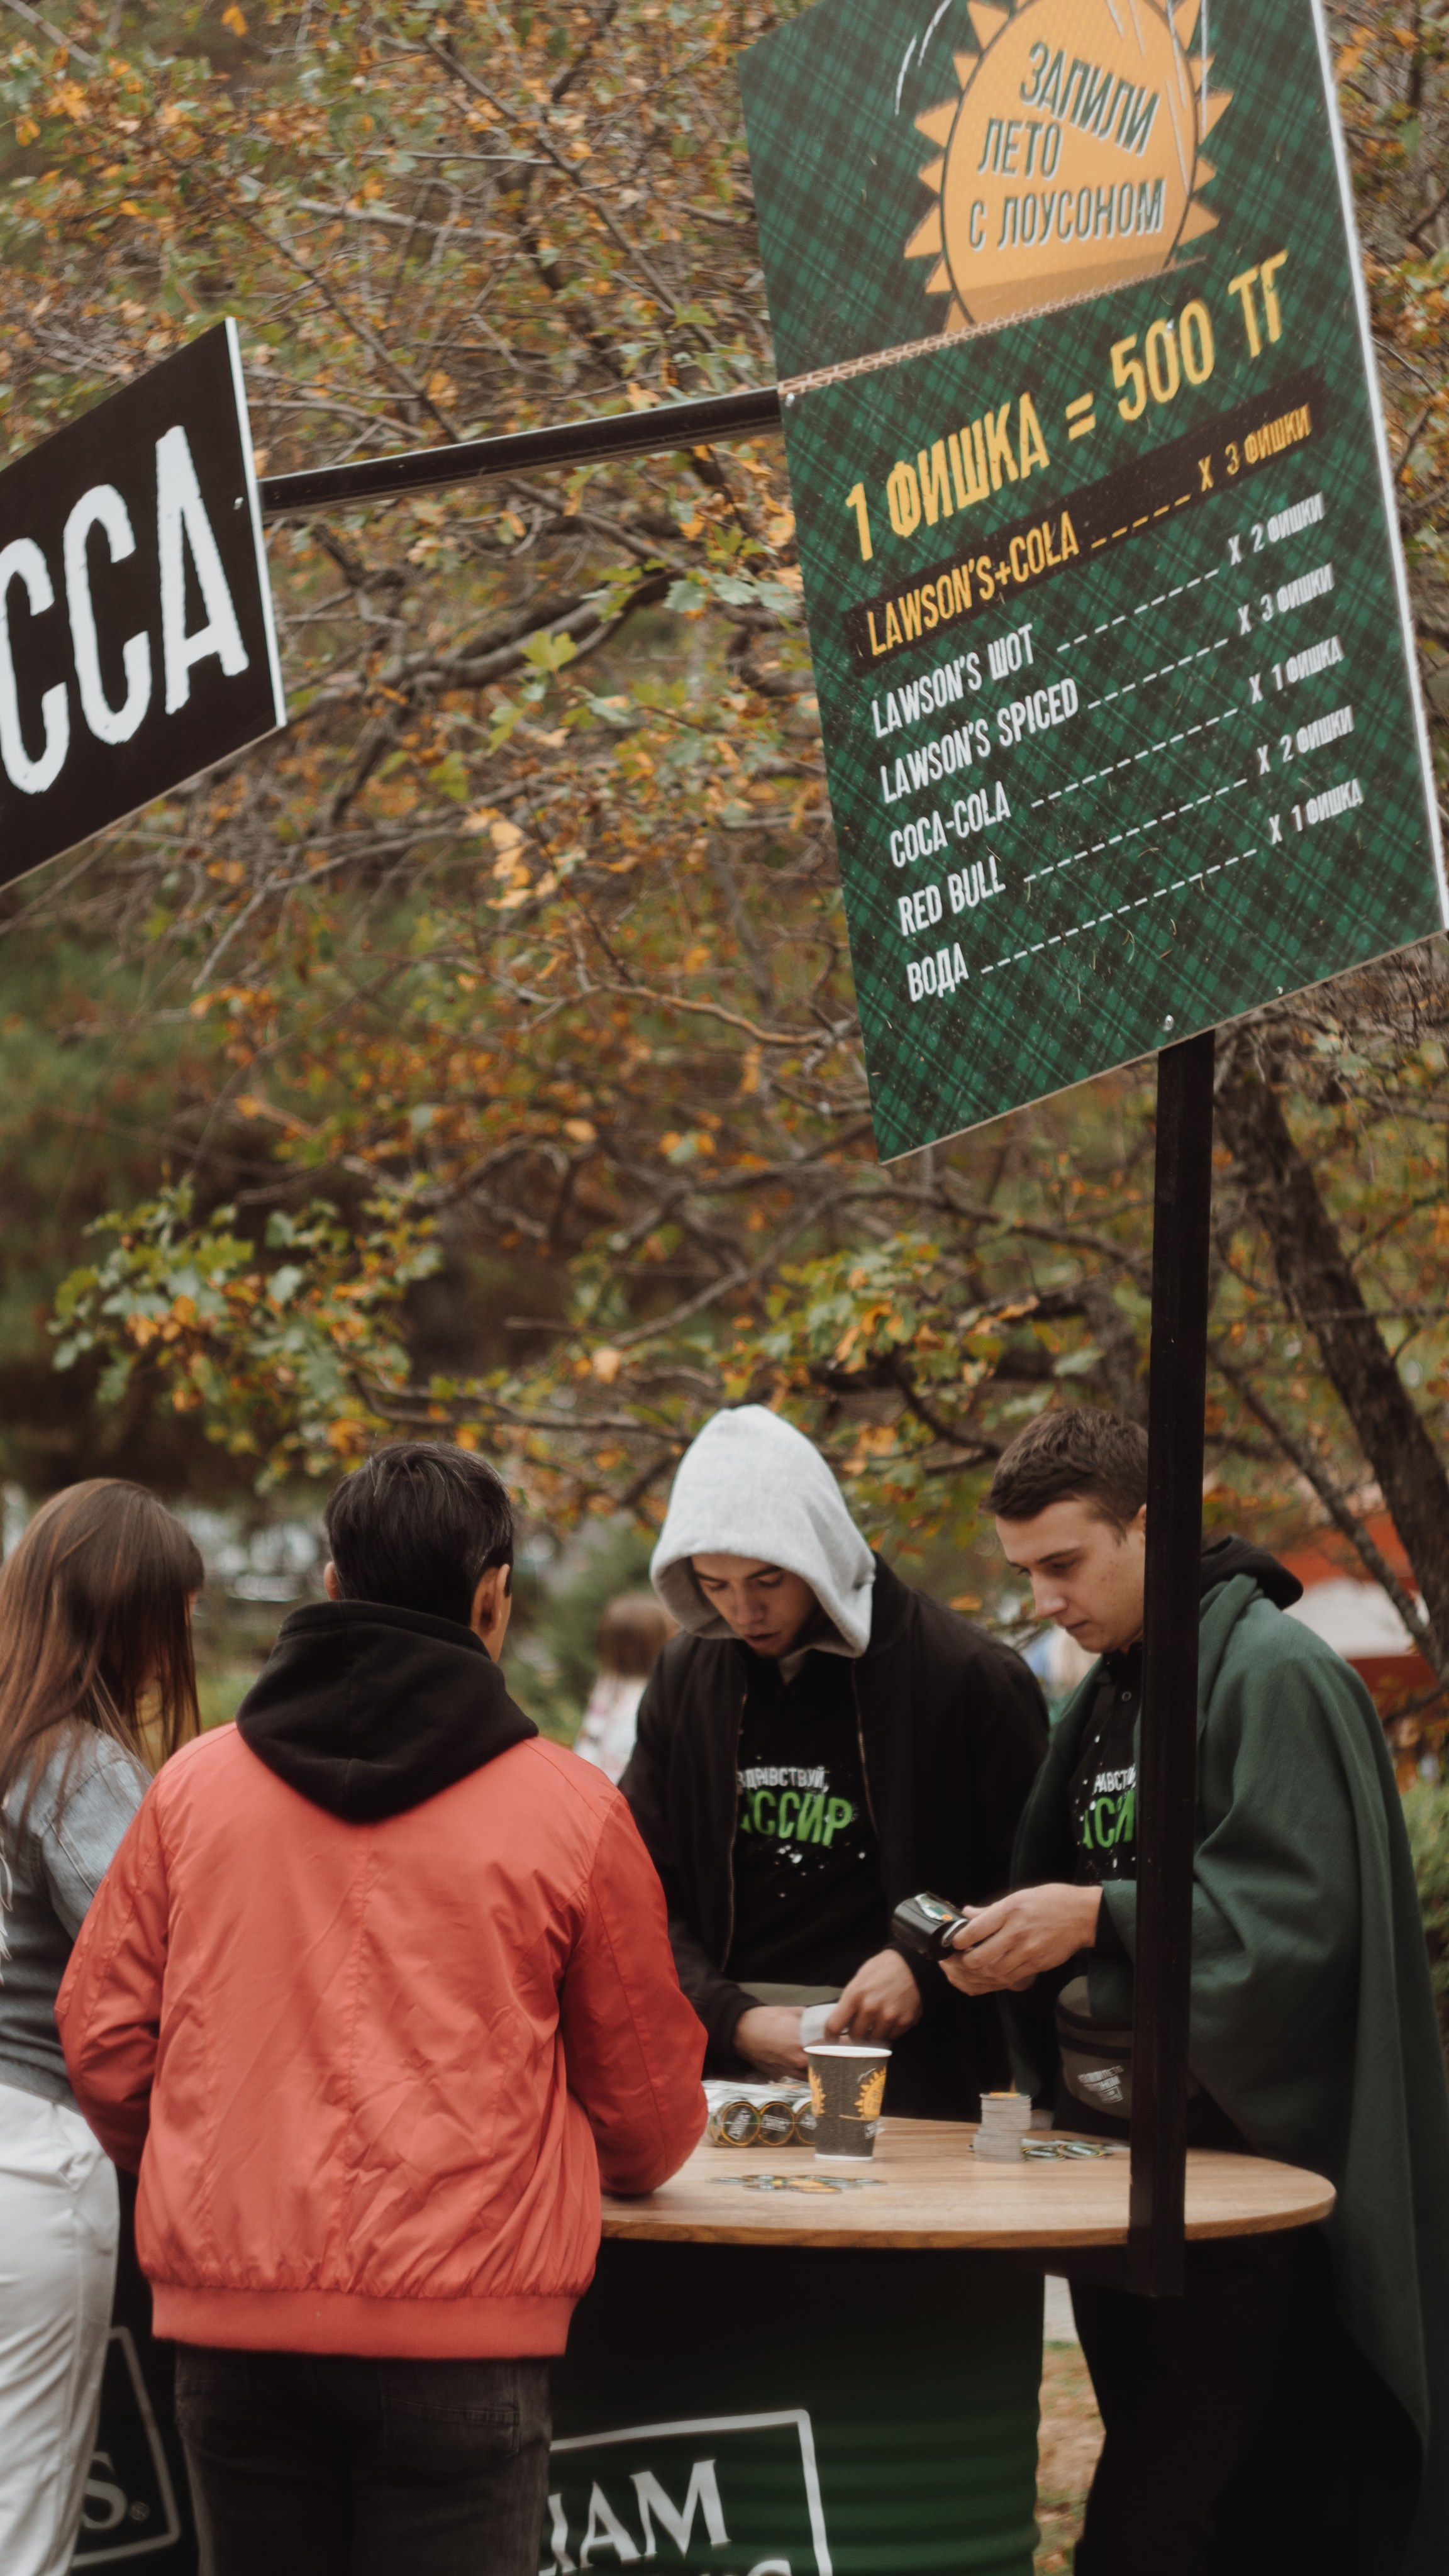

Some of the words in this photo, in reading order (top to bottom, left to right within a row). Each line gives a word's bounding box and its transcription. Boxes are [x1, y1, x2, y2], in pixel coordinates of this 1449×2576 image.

[969, 200, 987, 251] С
[997, 177, 1166, 250] ЛОУСОНОМ
[977, 118, 1062, 180] ЛЕТО
[1019, 41, 1159, 157] ЗАПИЛИ
[845, 482, 872, 562] 1
[886, 391, 1050, 538] ФИШКА
[1065, 392, 1096, 441] =
[1110, 299, 1215, 421] 500
[1228, 249, 1289, 358] ТГ
[0, 425, 249, 795] ССА
[867, 511, 1079, 656] LAWSON'S+COLA
[1224, 442, 1240, 475] 3
[1243, 403, 1312, 464] ФИШКИ
[872, 652, 983, 738] LAWSON'S
[987, 623, 1034, 680] ШОТ
[1251, 523, 1265, 553] 2
[1267, 491, 1325, 543] ФИШКИ
[880, 718, 991, 804] LAWSON'S
[997, 678, 1079, 747] SPICED
[1260, 594, 1274, 622] 3
[1276, 562, 1335, 613] ФИШКИ
[890, 780, 1011, 868] COCA-COLA
[1271, 663, 1284, 691] 1
[1285, 635, 1345, 684] ФИШКА
[897, 884, 943, 936] RED
[947, 855, 1006, 914] BULL
[1280, 734, 1294, 763] 2
[1296, 704, 1354, 753] ФИШКИ
[906, 942, 969, 1002] ВОДА
[1291, 804, 1303, 832] 1
[1306, 778, 1365, 825] ФИШКА
[539, 2458, 732, 2576] IAM
